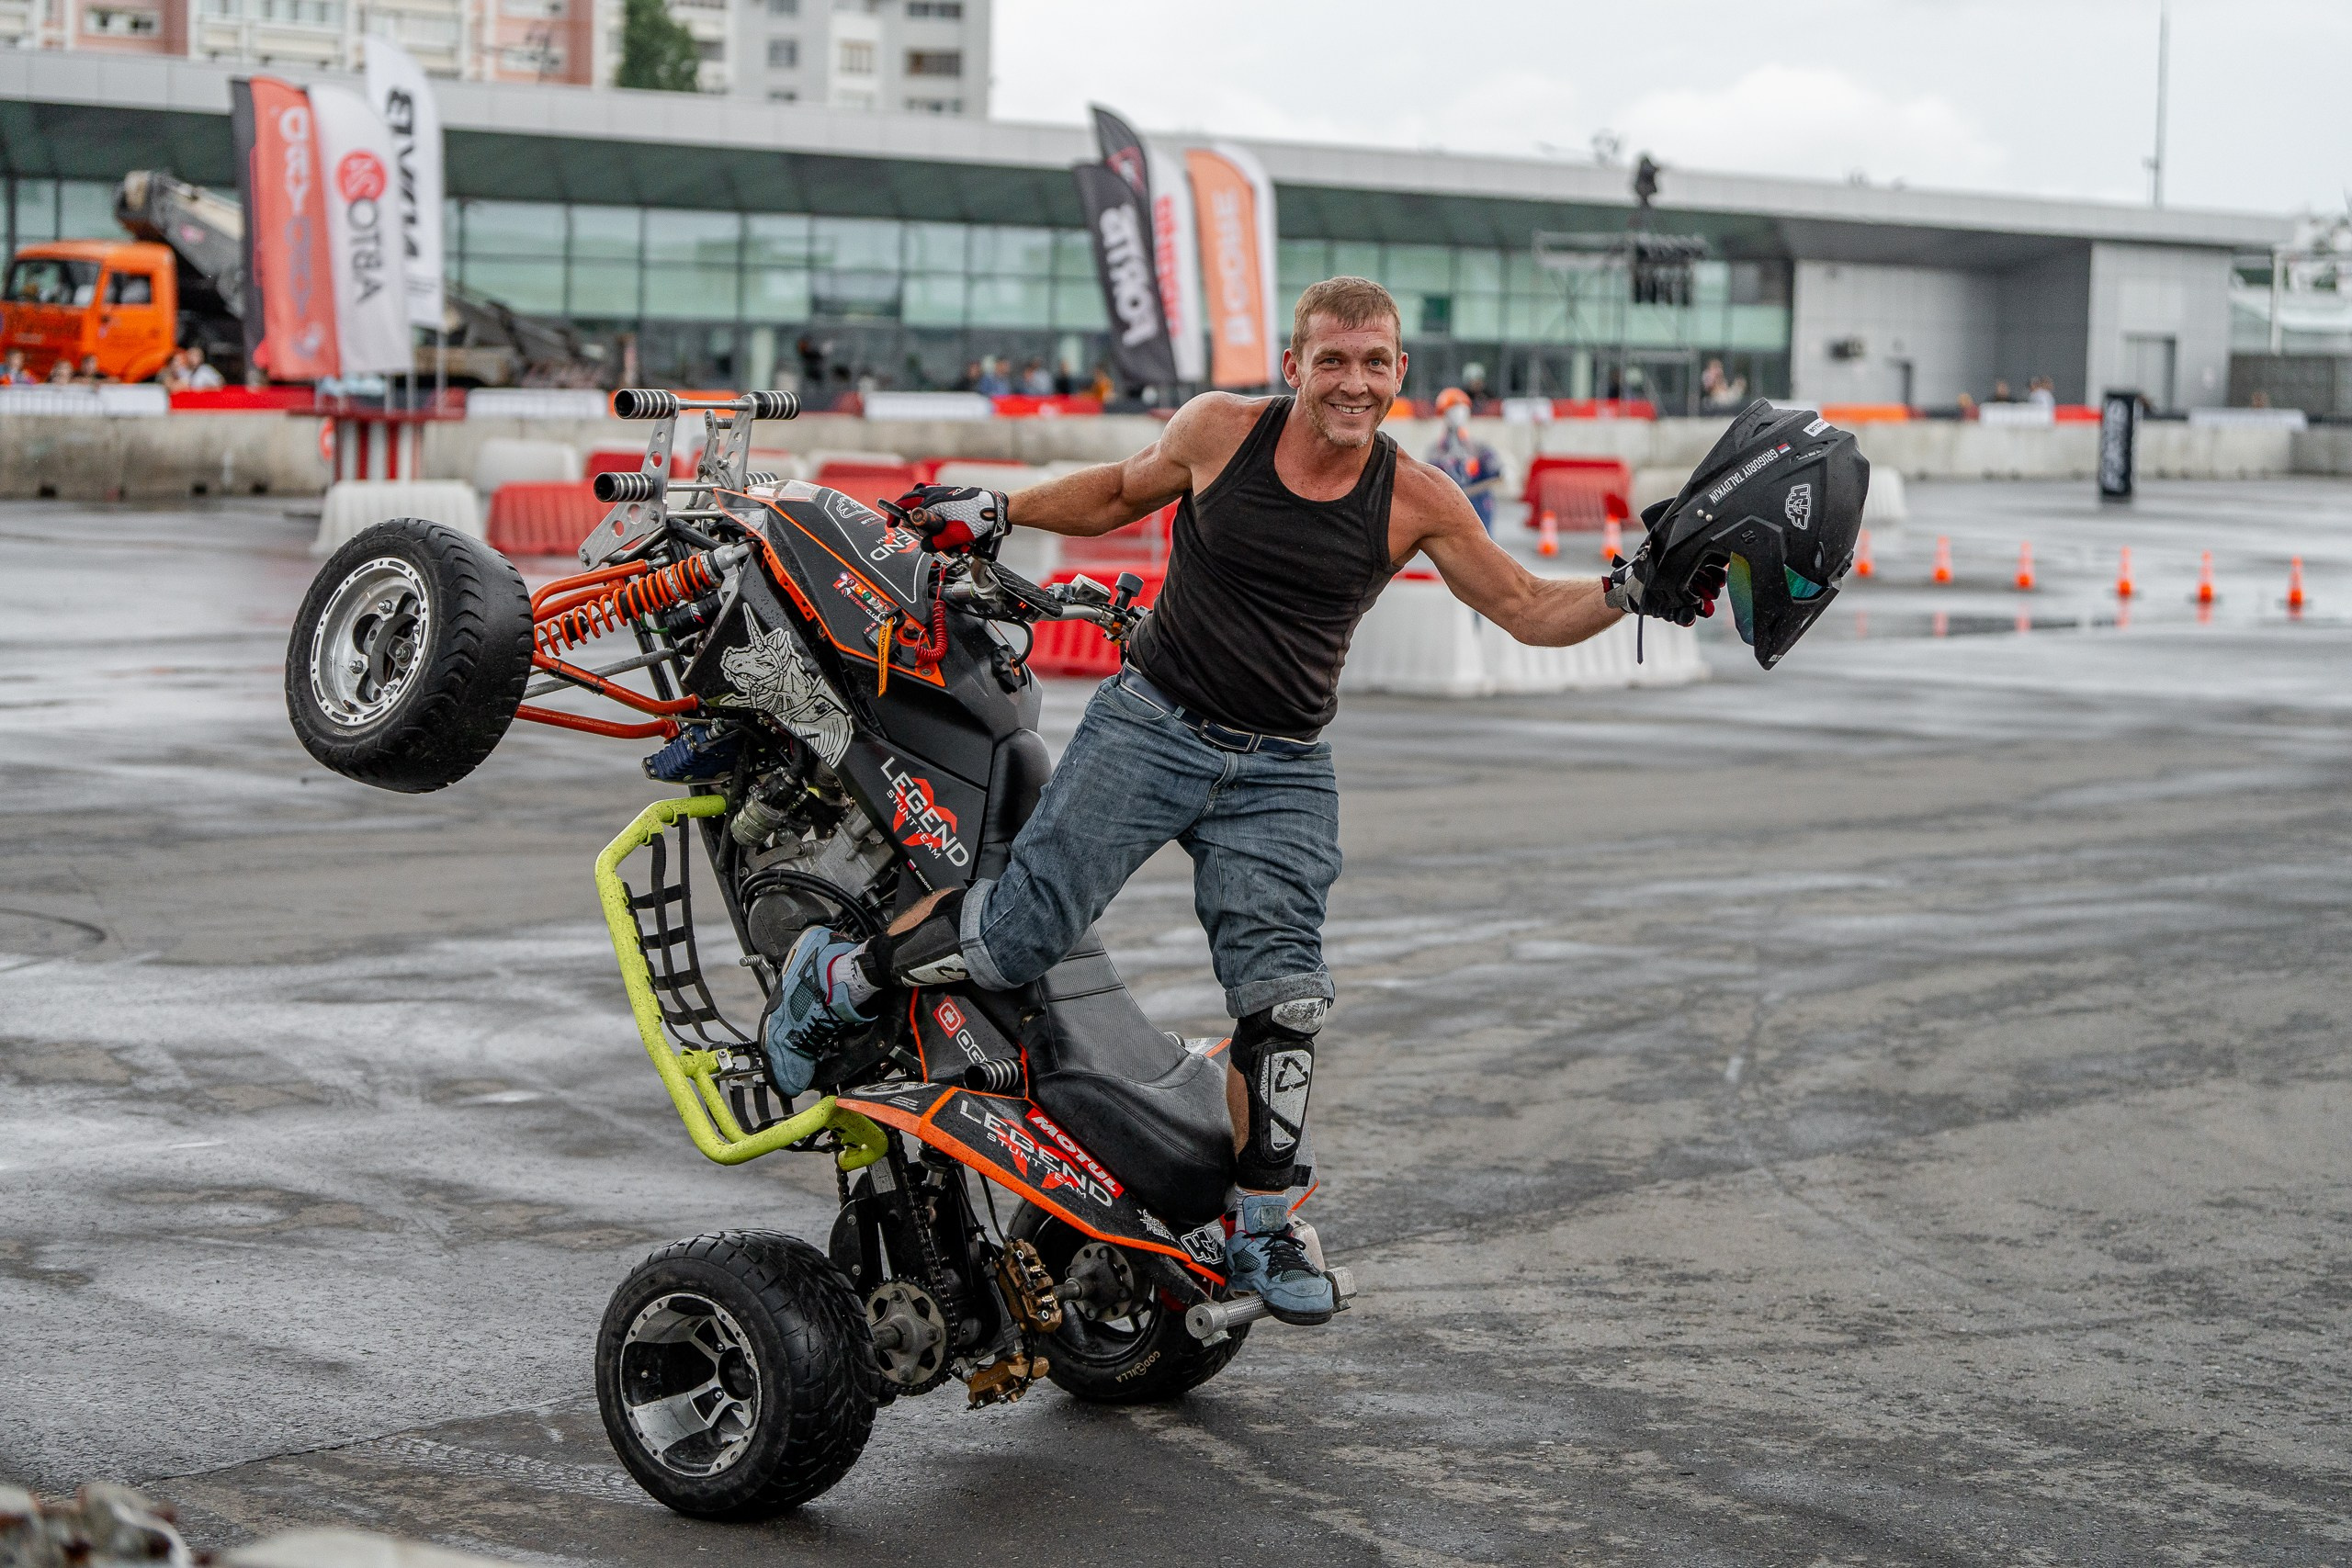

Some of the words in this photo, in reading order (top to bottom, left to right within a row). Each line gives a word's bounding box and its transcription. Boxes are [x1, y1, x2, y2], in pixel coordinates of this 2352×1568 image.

[1709, 472, 1745, 503] TALDYKIN
[1742, 448, 1779, 478] GRIGORIY
[870, 534, 918, 560] END
[880, 756, 969, 867] LEGEND
[886, 789, 917, 827] STUNT
[915, 826, 942, 859] TEAM
[956, 1028, 989, 1065] OG
[959, 1100, 1113, 1207] LEGEND
[986, 1133, 1042, 1167] STUNT
[1046, 1167, 1087, 1199] TEAM
[1031, 1116, 1118, 1192] MOTUL
